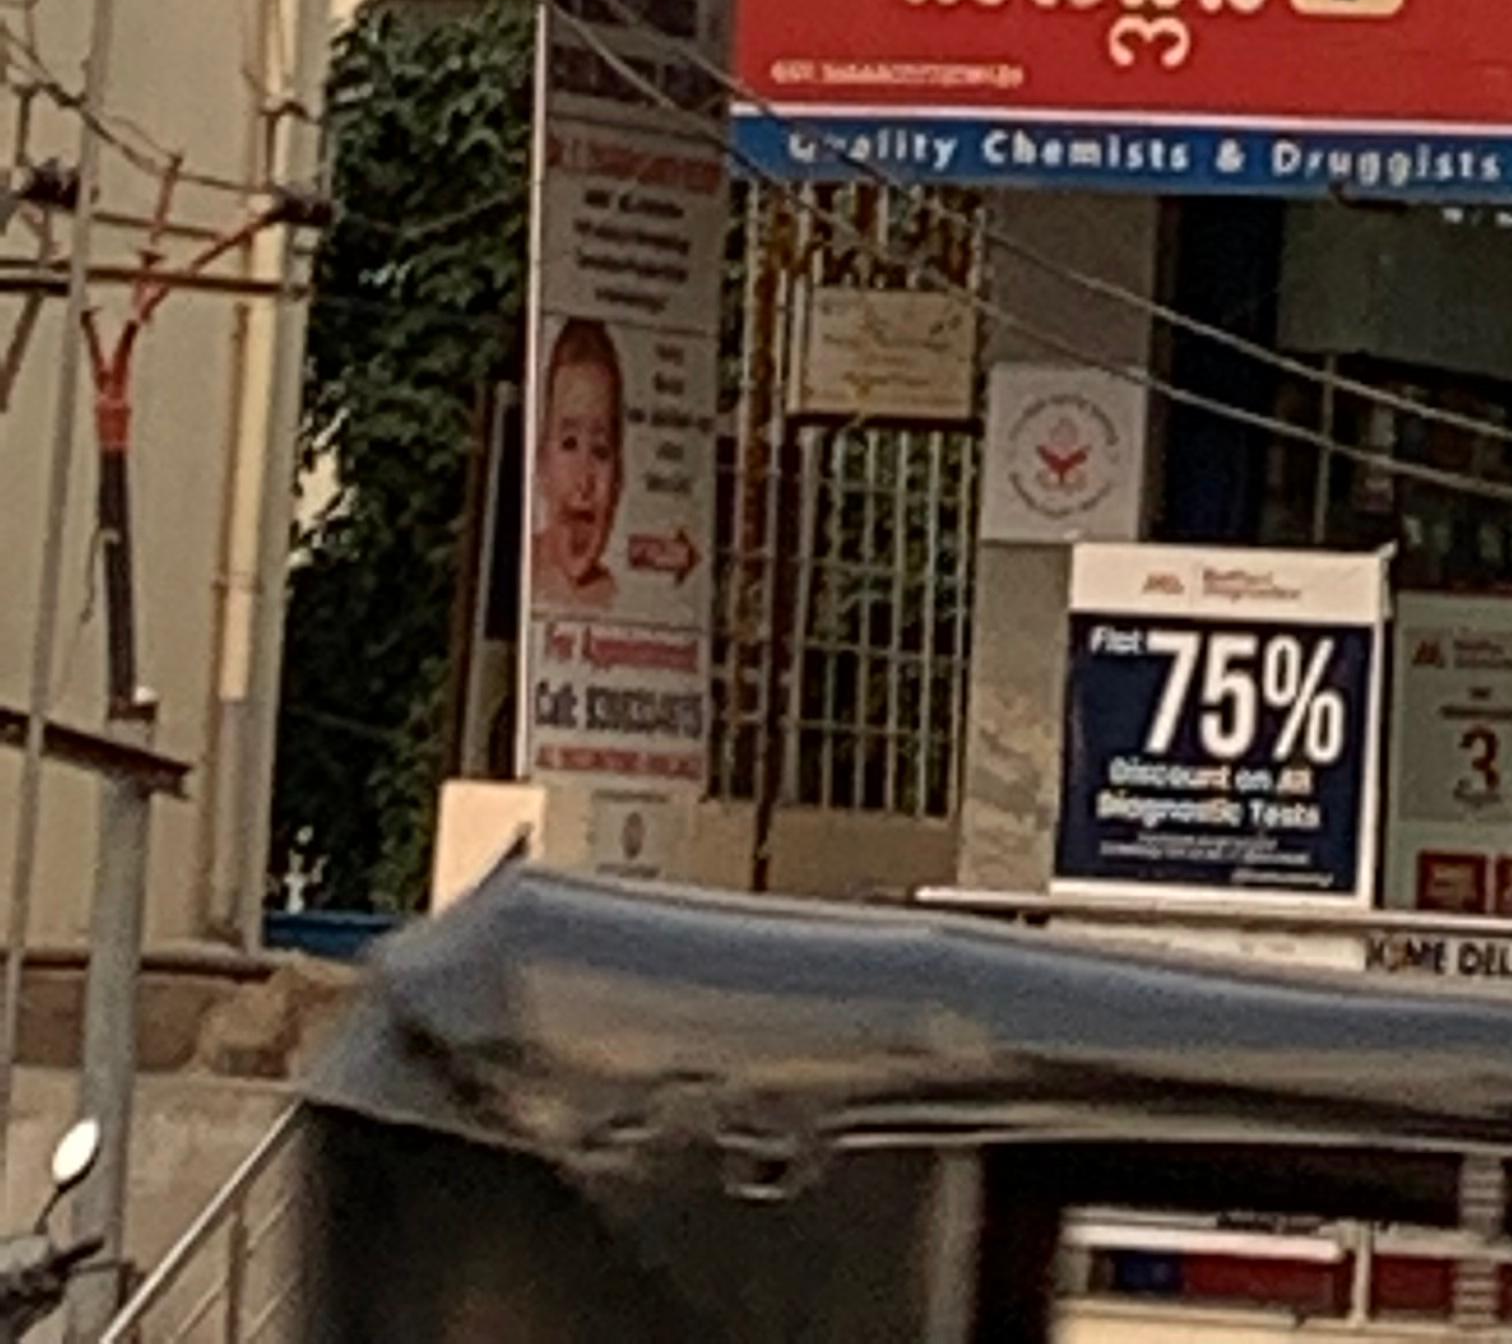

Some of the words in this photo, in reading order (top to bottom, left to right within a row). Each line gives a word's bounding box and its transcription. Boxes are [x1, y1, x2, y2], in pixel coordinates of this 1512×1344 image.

[982, 128, 1191, 174] Chemists
[1216, 141, 1244, 175] &
[1272, 140, 1503, 184] Druggists
[1143, 630, 1345, 762] 75%
[1108, 756, 1231, 789] Discount
[1235, 768, 1273, 792] on
